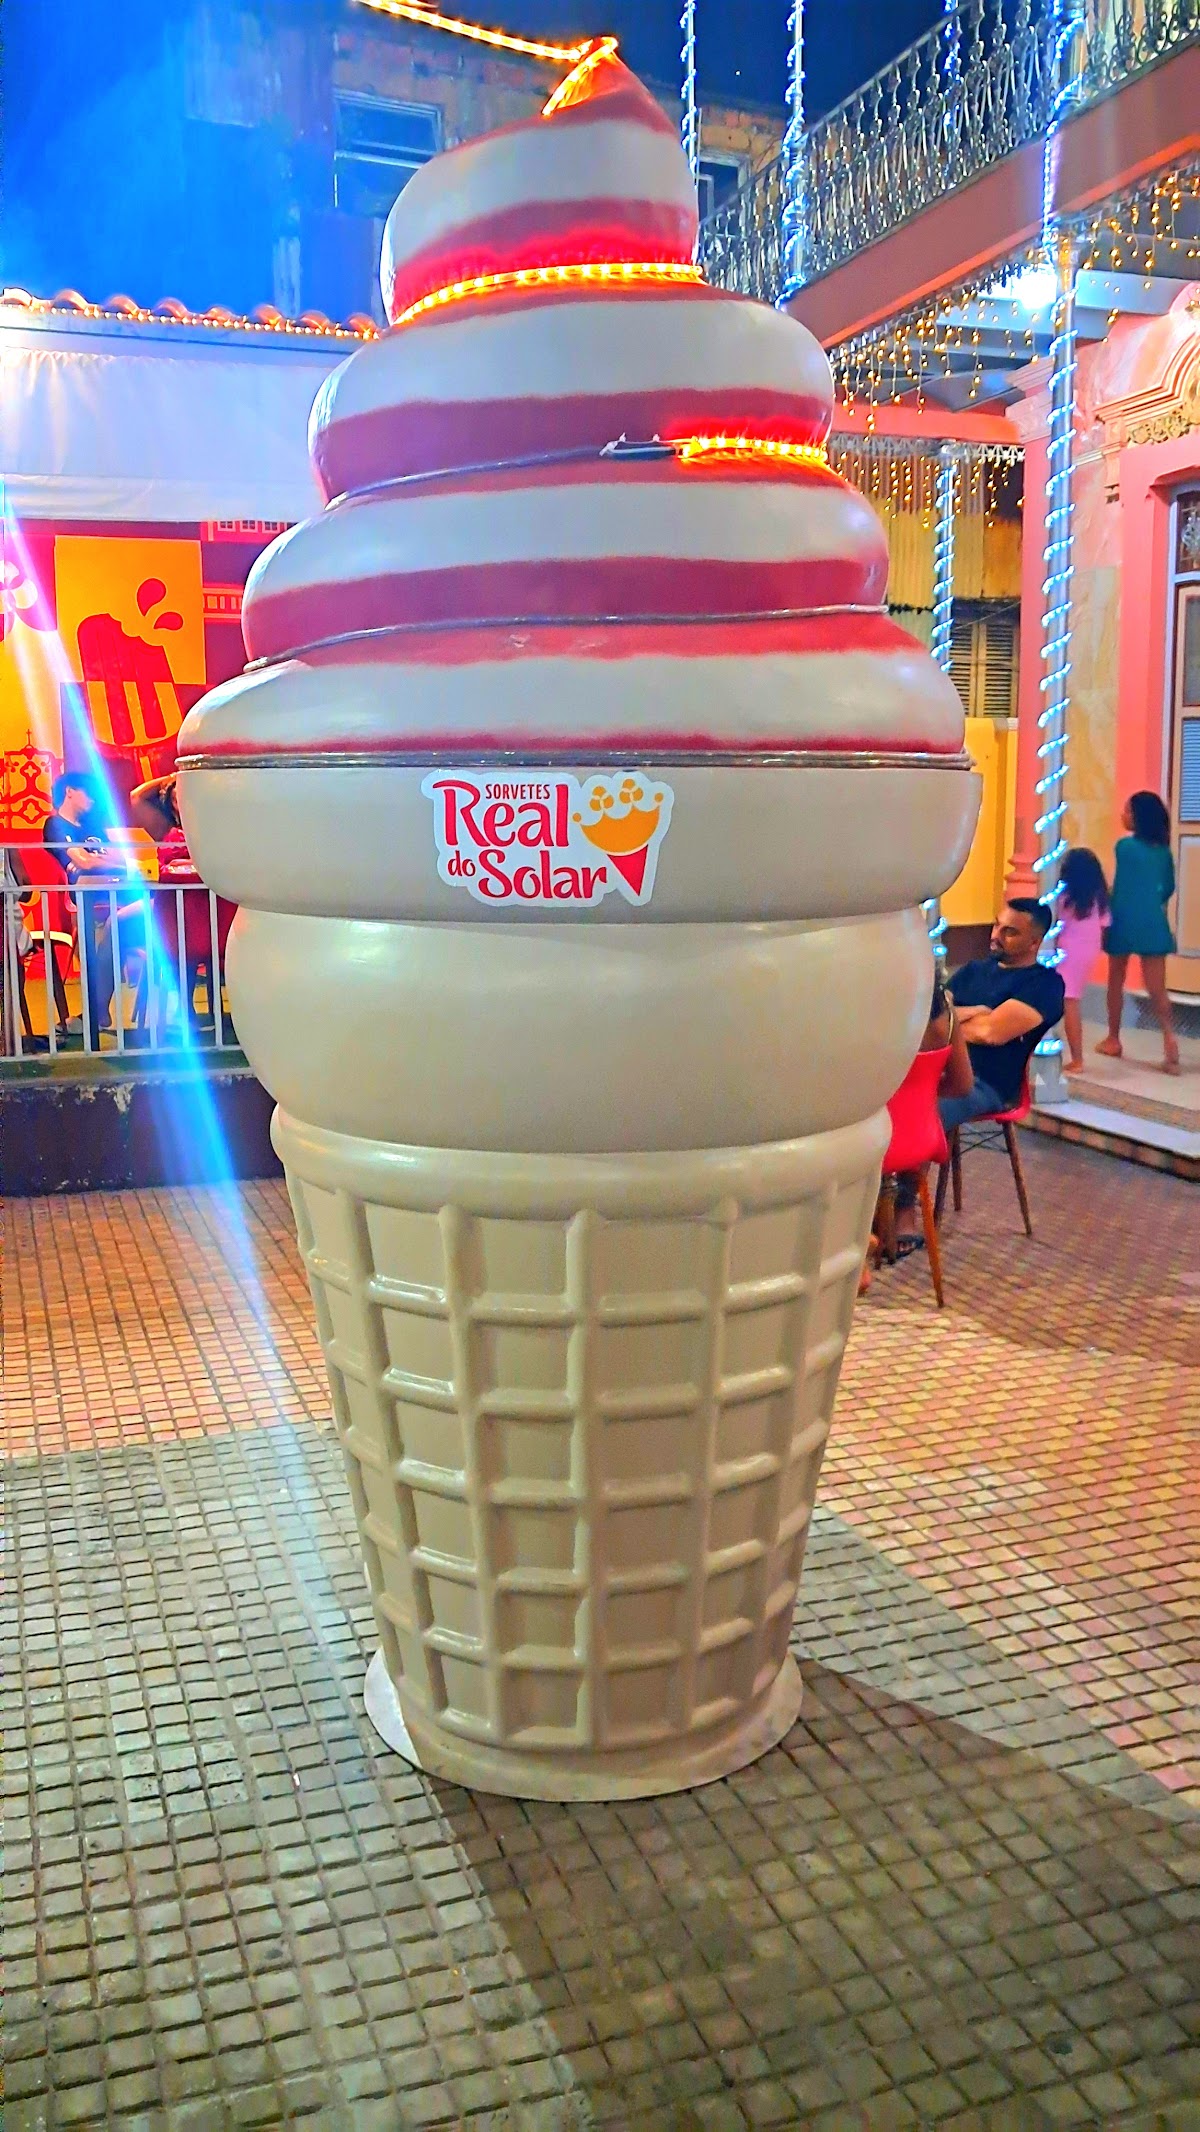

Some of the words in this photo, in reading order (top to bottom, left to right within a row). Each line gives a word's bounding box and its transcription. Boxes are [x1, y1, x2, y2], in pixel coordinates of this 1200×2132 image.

[432, 779, 569, 847] Real
[485, 783, 550, 799] SORVETES
[447, 850, 476, 876] do
[478, 849, 607, 898] Solar
